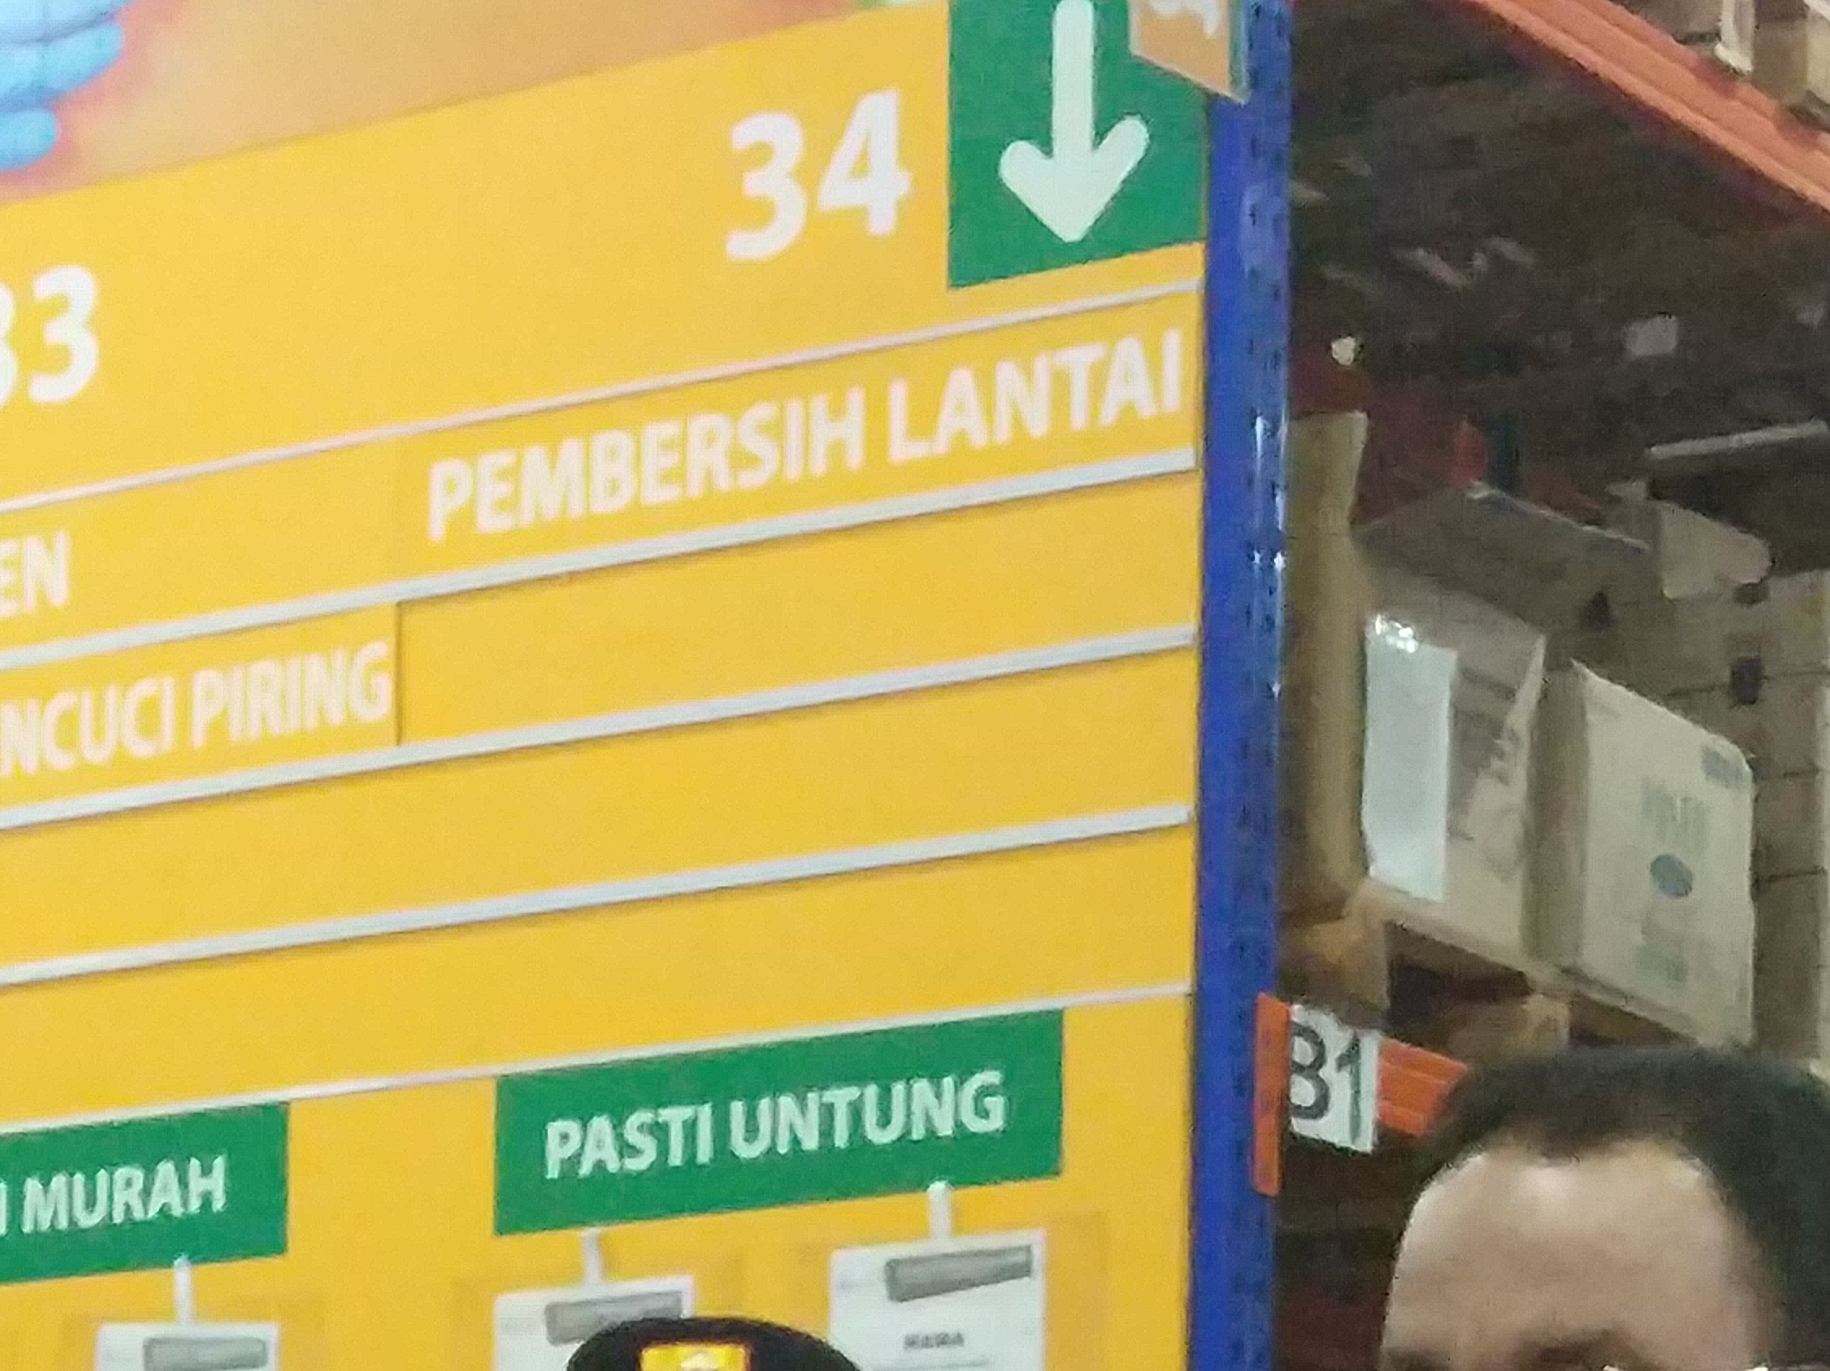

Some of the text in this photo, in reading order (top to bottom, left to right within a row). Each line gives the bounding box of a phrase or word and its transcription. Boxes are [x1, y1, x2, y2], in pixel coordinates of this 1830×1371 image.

[725, 86, 912, 262] 34
[428, 328, 1183, 543] PEMBERSIH LANTAI
[190, 640, 390, 749] PIRING
[545, 1069, 1006, 1179] PASTI UNTUNG
[22, 1153, 226, 1235] MURAH
